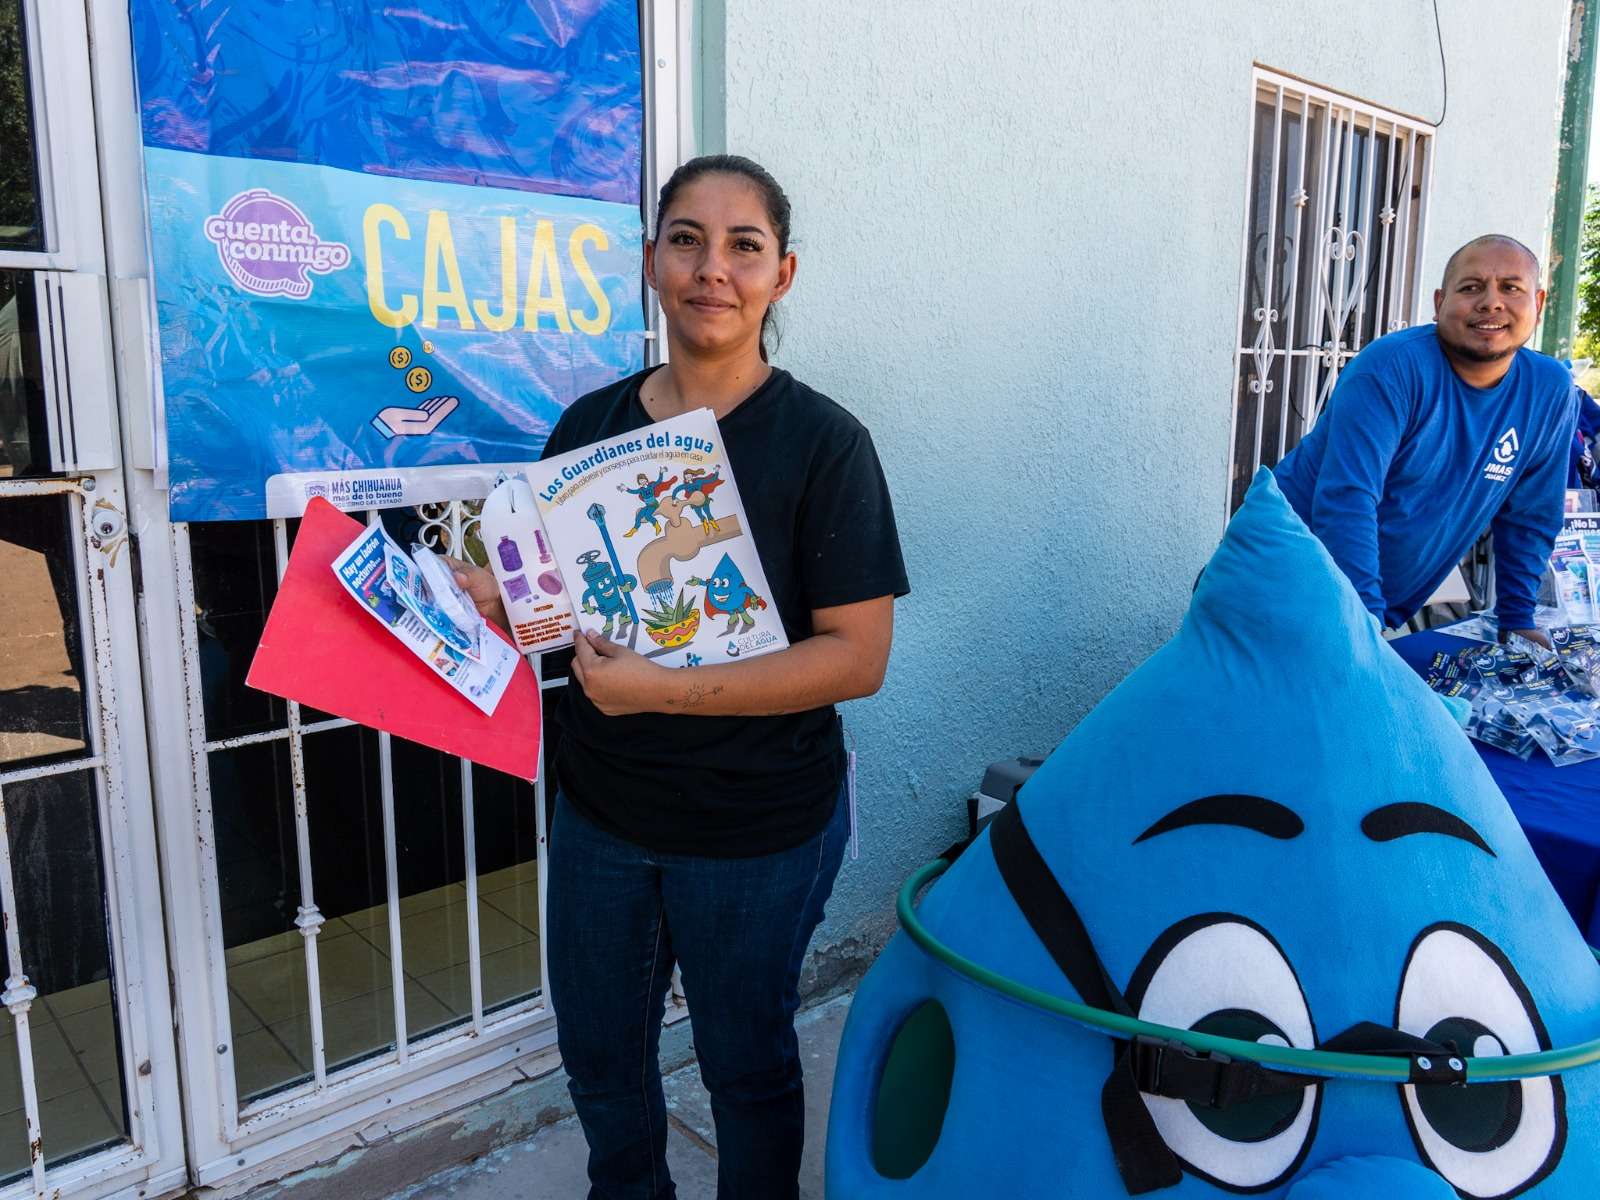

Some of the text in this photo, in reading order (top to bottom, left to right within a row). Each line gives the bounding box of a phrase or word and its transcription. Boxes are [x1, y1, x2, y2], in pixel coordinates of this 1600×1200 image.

[208, 220, 311, 244] cuenta
[229, 240, 349, 268] conmigo
[362, 203, 611, 335] CAJAS
[539, 432, 714, 503] Los Guardianes del agua
[568, 483, 580, 496] para
[578, 472, 600, 486] colorear
[603, 460, 627, 473] consejos
[627, 456, 640, 466] para
[664, 450, 680, 460] agua
[1484, 462, 1514, 476] JMAS
[332, 478, 402, 494] MÁS CHIHUAHUA
[352, 492, 364, 500] de
[366, 492, 374, 500] lo
[376, 490, 403, 498] bueno
[1570, 518, 1598, 530] ¡No la
[342, 562, 358, 579] Hay
[354, 555, 364, 567] un
[360, 538, 380, 559] ladrón
[737, 630, 772, 644] CULTURA
[740, 642, 754, 651] DEL
[755, 635, 778, 646] AGUA
